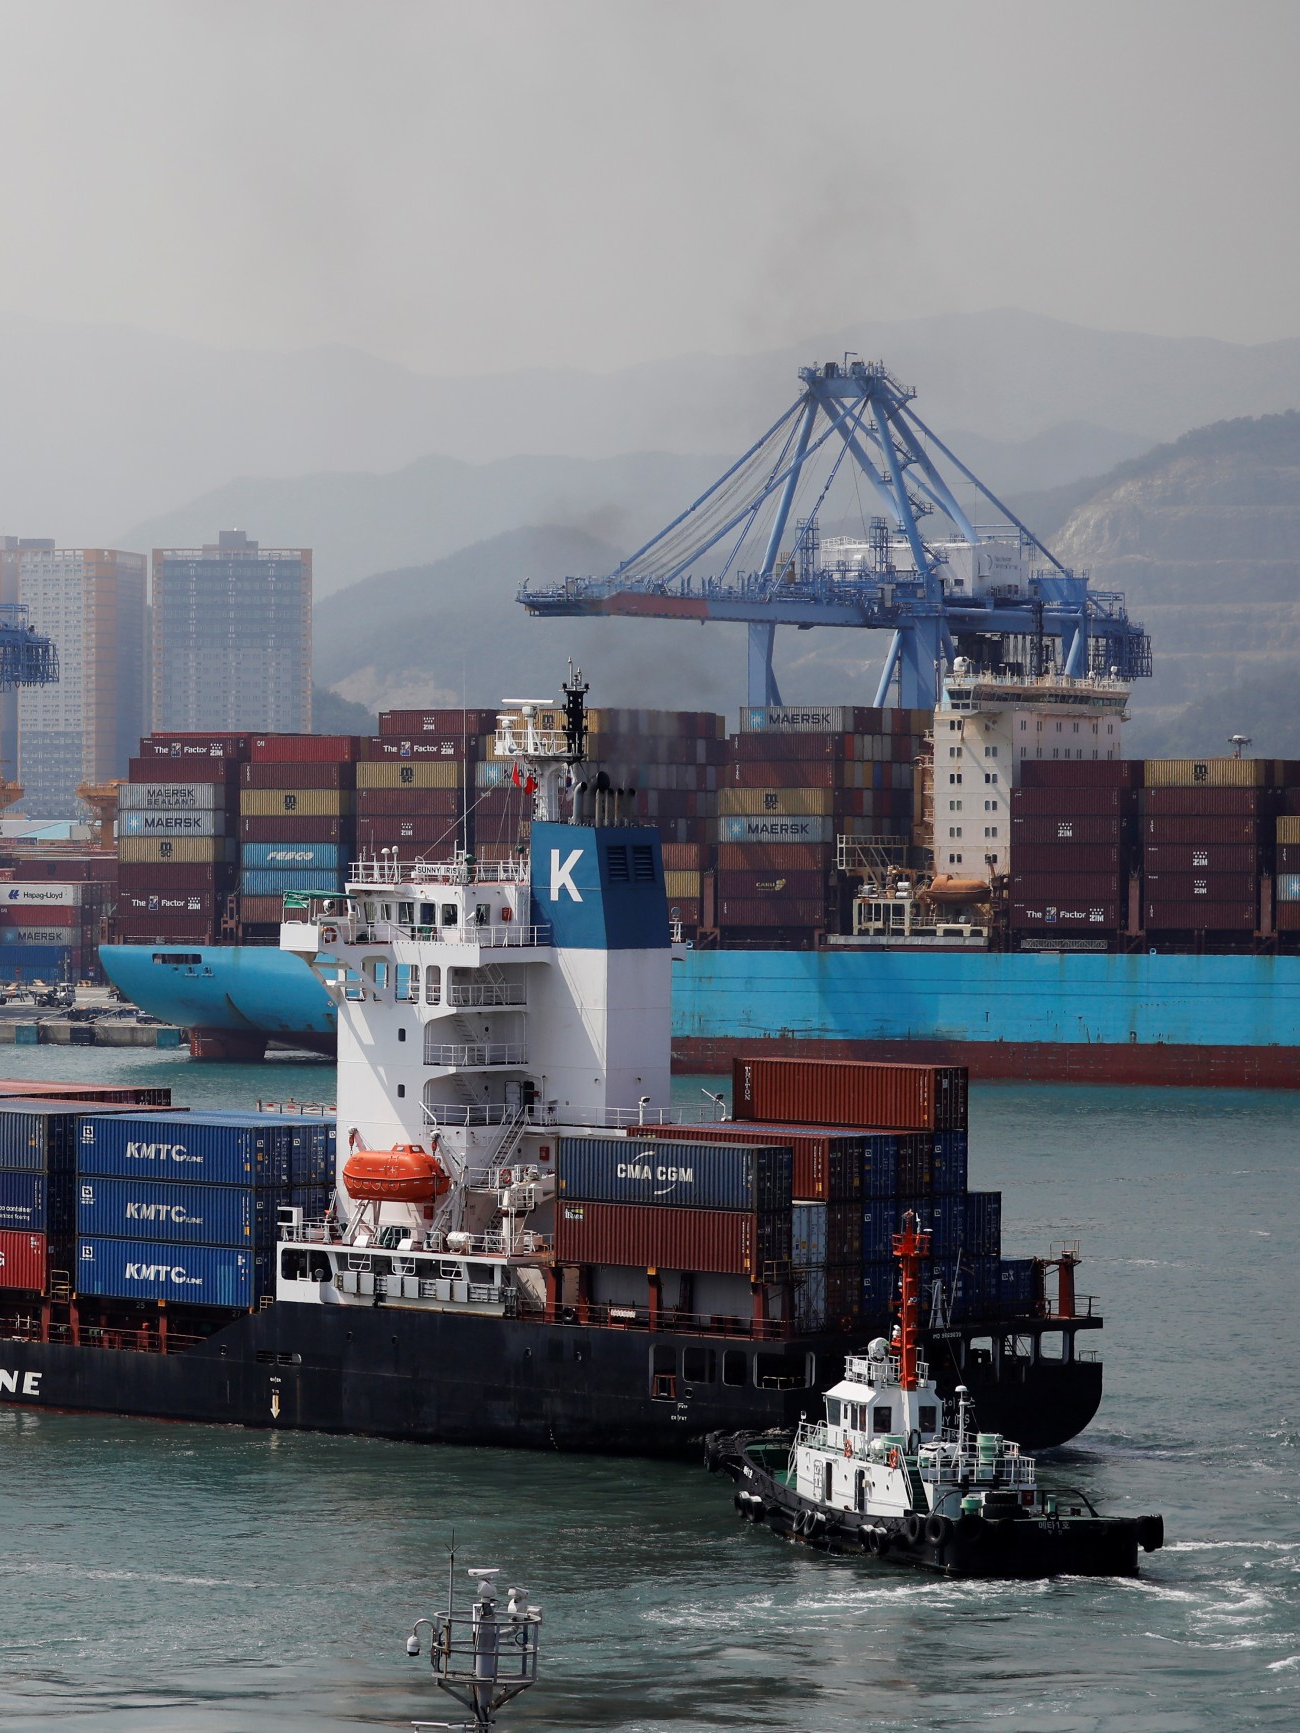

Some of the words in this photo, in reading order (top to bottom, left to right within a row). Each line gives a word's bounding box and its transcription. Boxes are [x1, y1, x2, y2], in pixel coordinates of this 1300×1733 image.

[769, 714, 830, 724] MAERSK
[147, 789, 195, 797] MAERSK
[144, 818, 202, 828] MAERSK
[748, 823, 810, 834] MAERSK
[417, 866, 440, 874] SUNNY
[444, 867, 457, 875] IRIS
[550, 848, 585, 903] K
[23, 891, 63, 900] Hapag-Lloyd
[1026, 910, 1042, 918] The
[1060, 910, 1086, 918] Factor
[17, 932, 63, 941] MAERSK
[126, 1141, 187, 1162] KMTC
[617, 1163, 652, 1180] CMA
[657, 1166, 693, 1183] CGM
[6, 1205, 32, 1213] container
[126, 1202, 187, 1223] KMTC
[125, 1263, 187, 1283] KMTC
